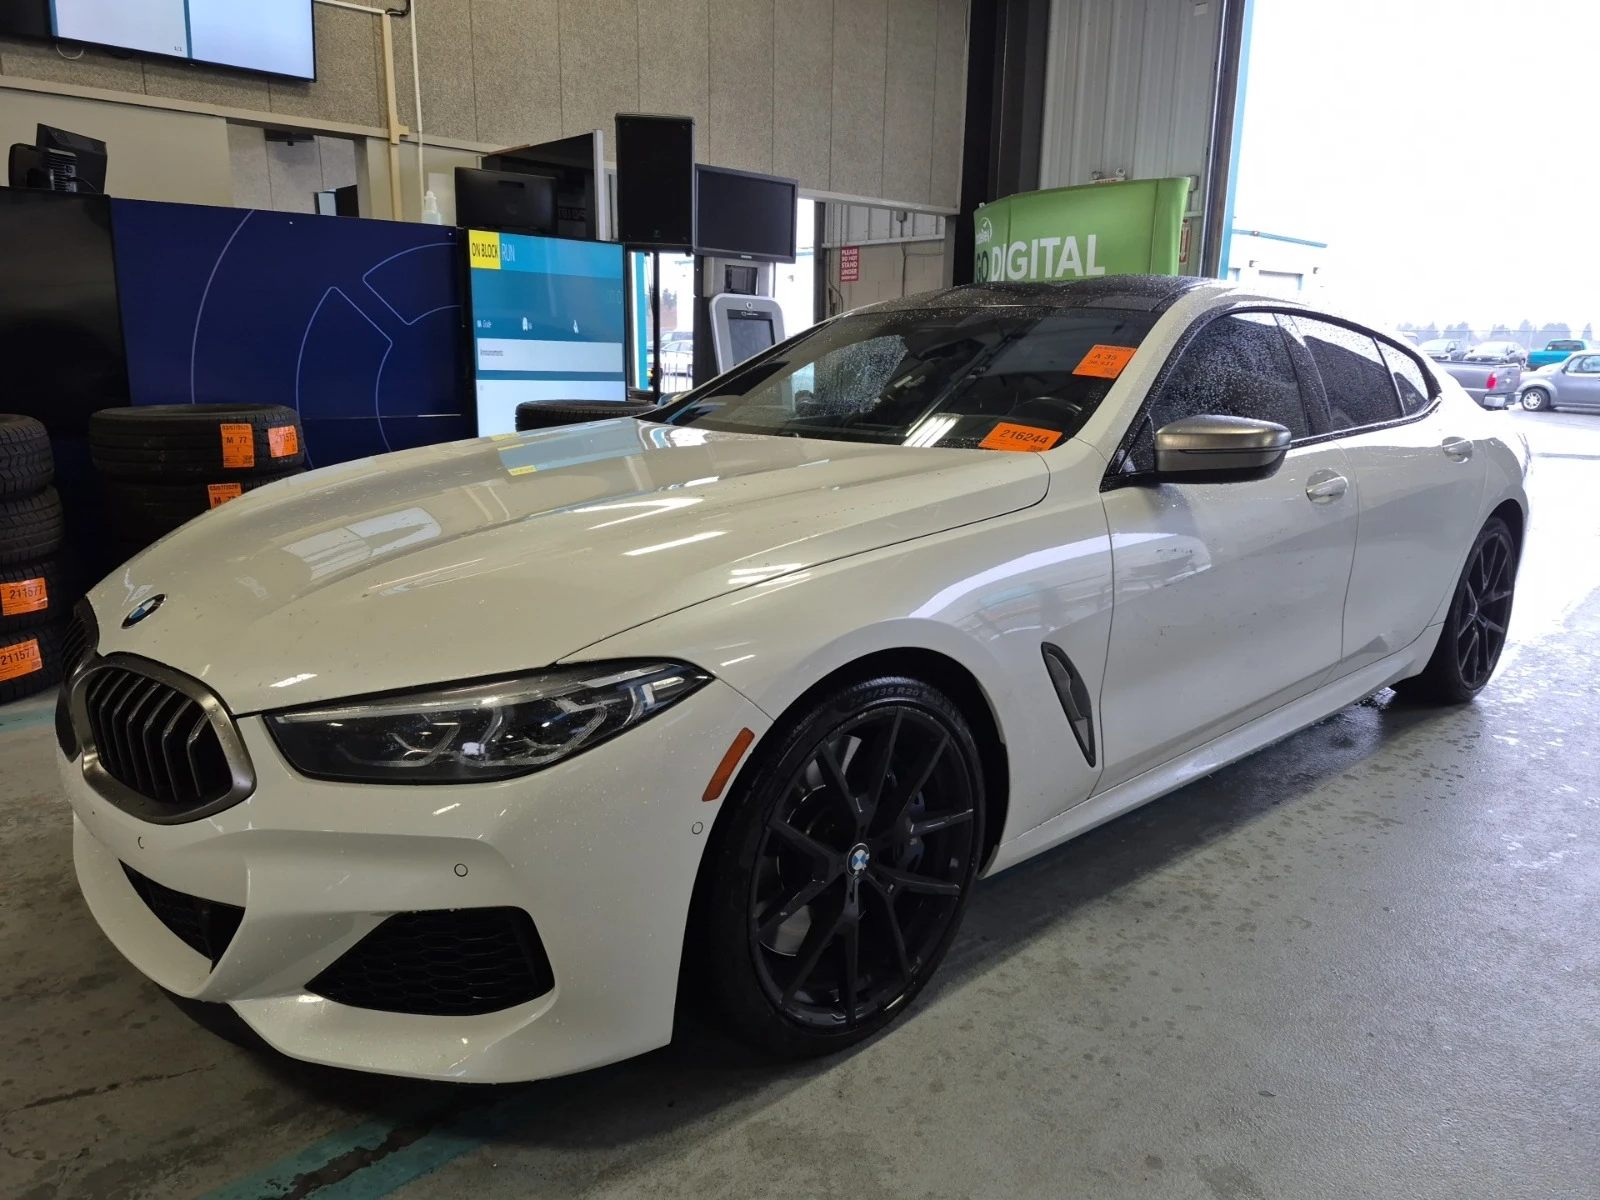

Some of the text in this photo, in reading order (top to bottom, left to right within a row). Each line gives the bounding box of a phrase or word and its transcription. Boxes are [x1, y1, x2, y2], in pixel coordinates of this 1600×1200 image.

[471, 242, 516, 262] ON BLOCK RUN
[976, 250, 990, 284] GO
[991, 233, 1106, 281] DIGITAL
[226, 436, 247, 444] M 77
[1000, 429, 1050, 445] 216244
[213, 496, 222, 505] M
[0, 646, 36, 666] 211577
